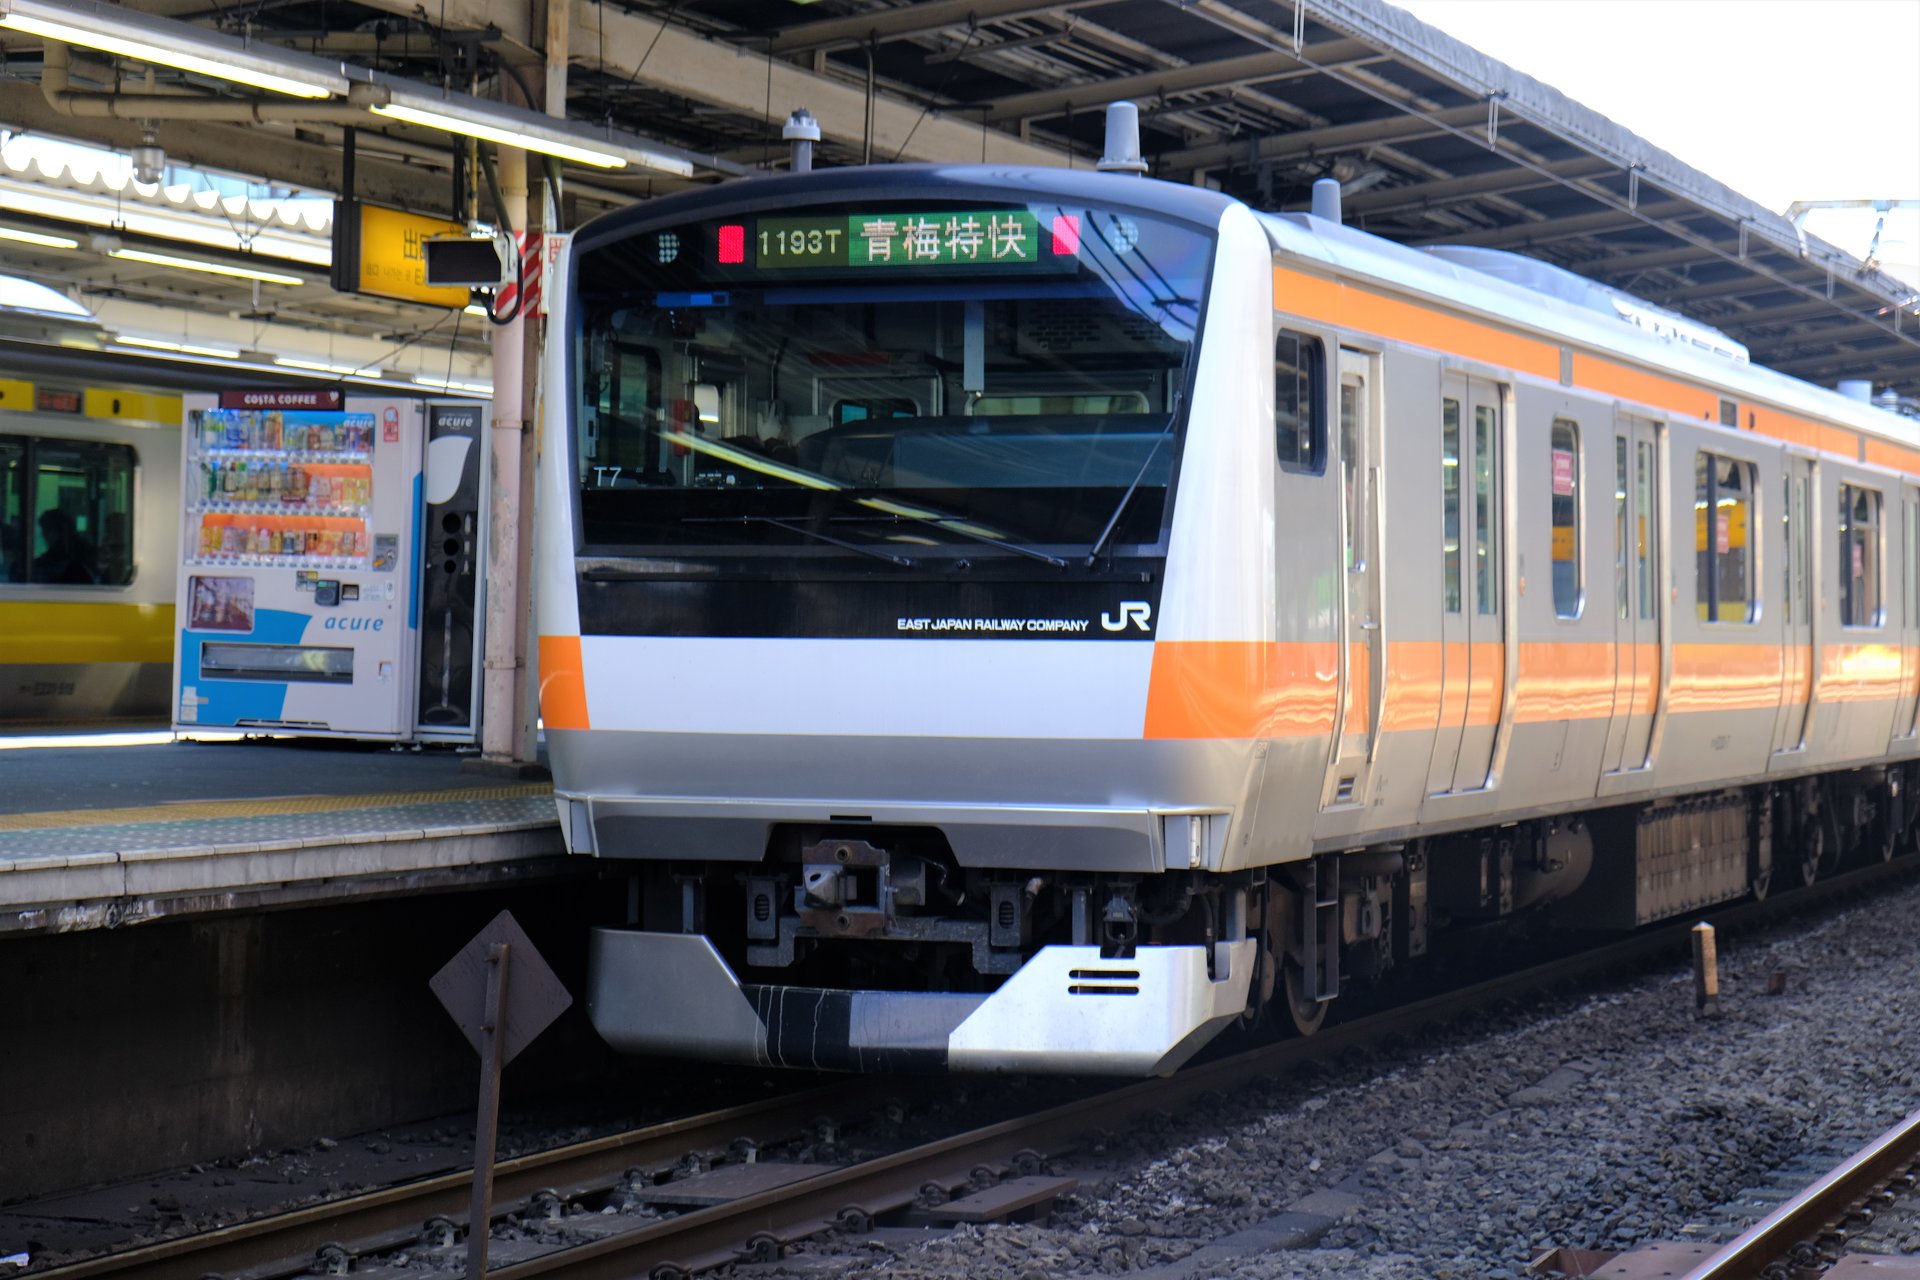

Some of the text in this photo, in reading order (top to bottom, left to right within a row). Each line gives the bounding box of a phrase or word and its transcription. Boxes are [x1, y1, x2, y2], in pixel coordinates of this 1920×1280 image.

[759, 229, 842, 255] 1193T
[860, 214, 1027, 262] 青梅特快
[244, 394, 317, 405] COSTA COFFEE
[438, 417, 473, 427] acure
[593, 466, 622, 487] T7
[324, 615, 384, 631] acure
[1100, 601, 1151, 631] JR
[897, 619, 1089, 632] EAST JAPAN RAILWAY COMPANY
